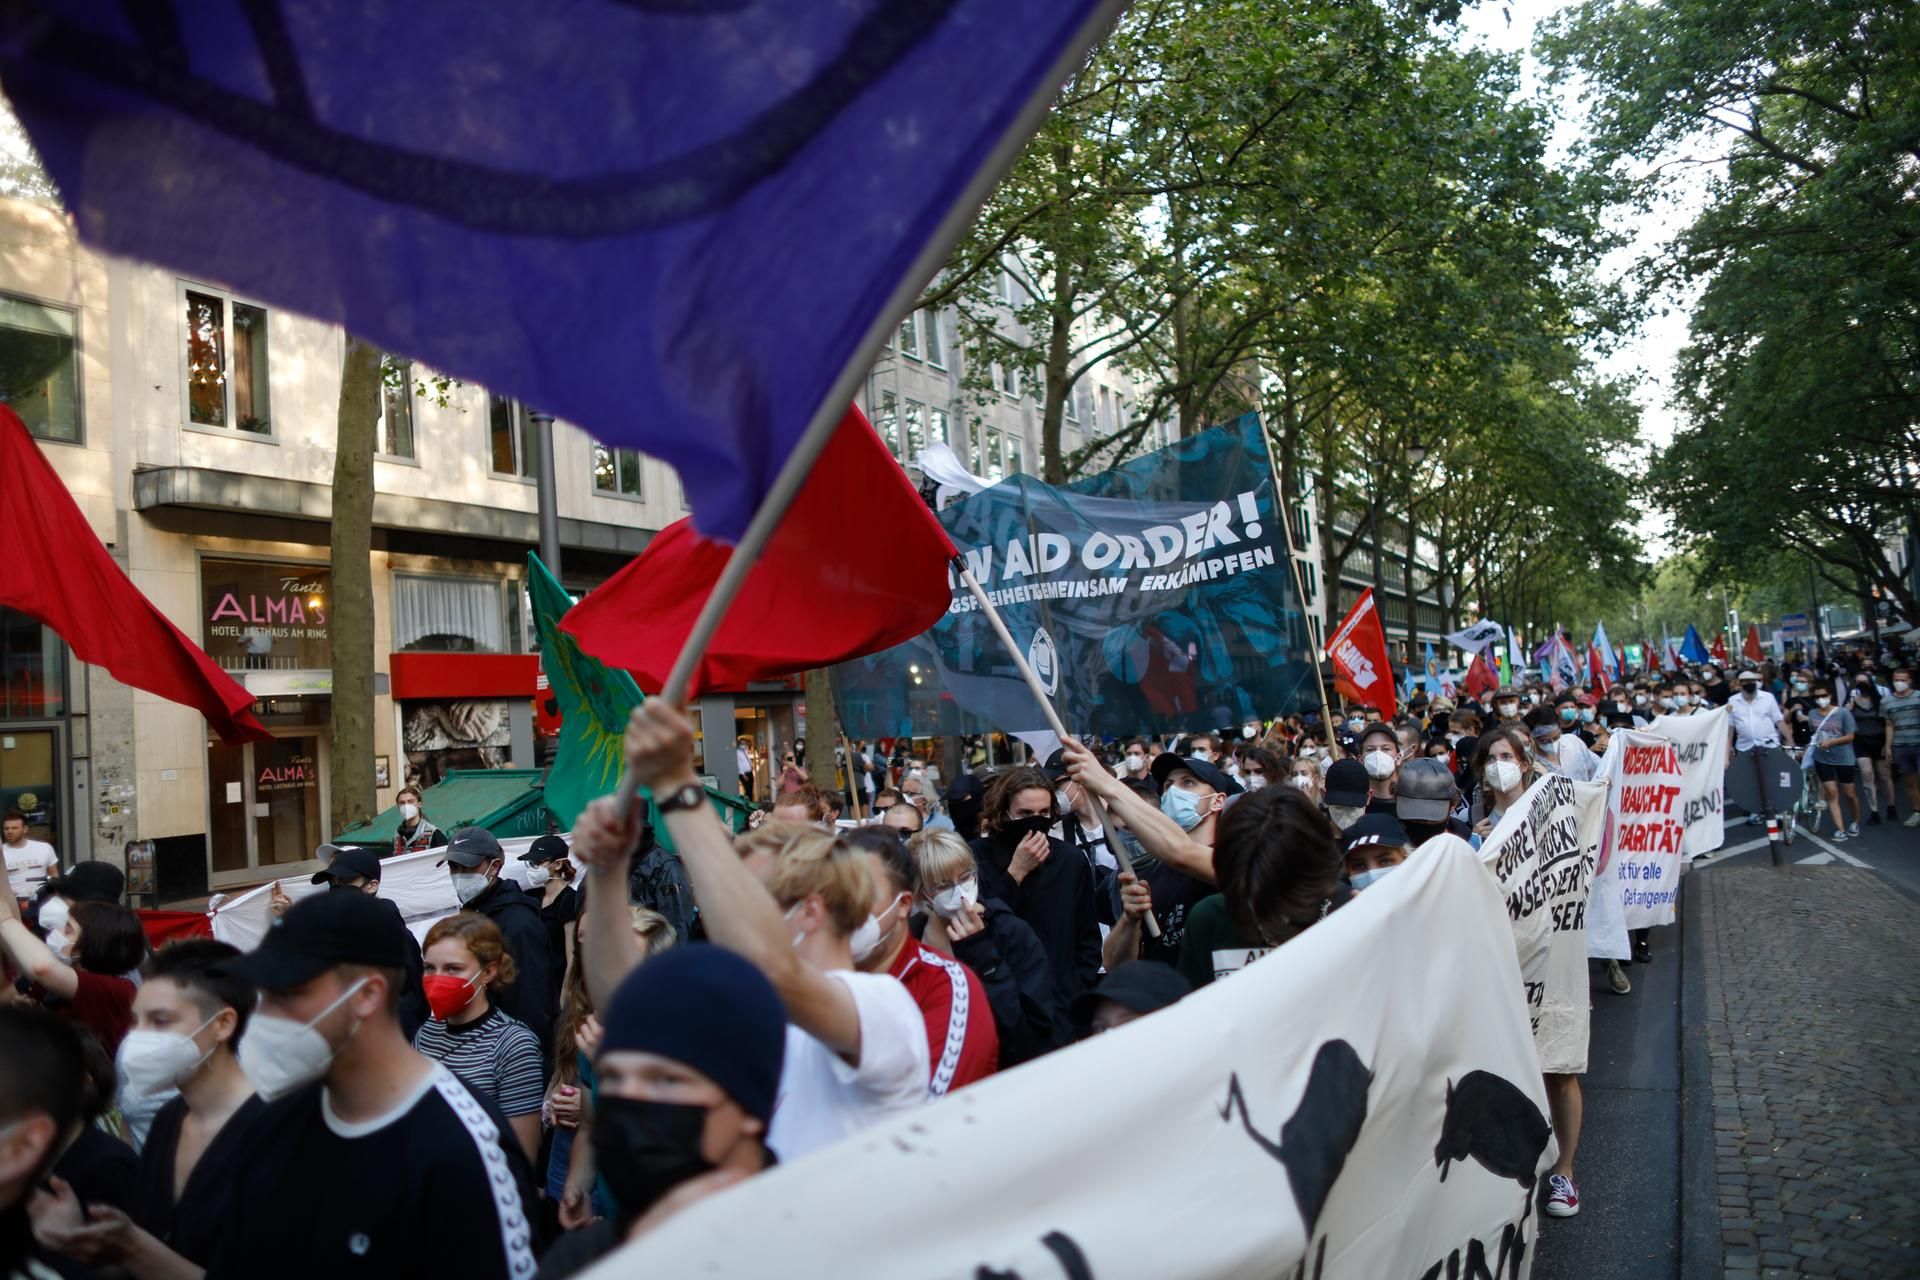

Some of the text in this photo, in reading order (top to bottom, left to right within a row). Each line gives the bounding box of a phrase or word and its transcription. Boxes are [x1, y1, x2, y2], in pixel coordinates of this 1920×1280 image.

[1081, 490, 1263, 571] ORDER!
[1139, 545, 1275, 592] ERKÄMPFEN
[279, 577, 325, 593] Tante
[211, 626, 241, 637] HOTEL
[291, 629, 304, 638] AM
[307, 629, 327, 639] RING
[1628, 862, 1641, 879] für
[1643, 862, 1661, 880] alle
